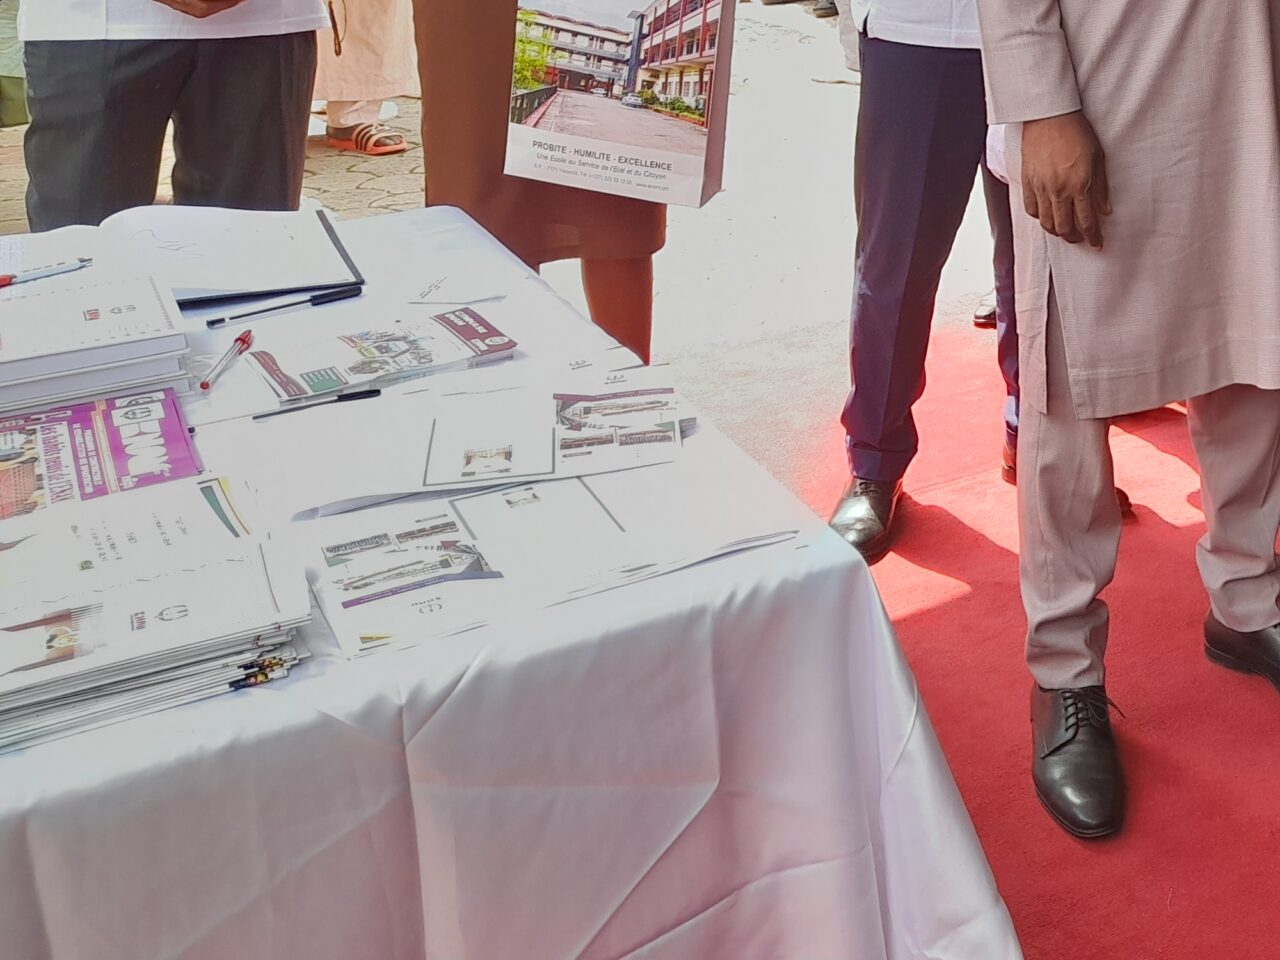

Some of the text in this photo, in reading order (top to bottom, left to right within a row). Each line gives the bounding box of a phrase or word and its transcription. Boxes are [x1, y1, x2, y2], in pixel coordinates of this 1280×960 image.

[532, 140, 567, 154] PROBITE
[573, 148, 612, 162] HUMILITE
[618, 155, 672, 171] EXCELLENCE
[578, 159, 600, 170] Service
